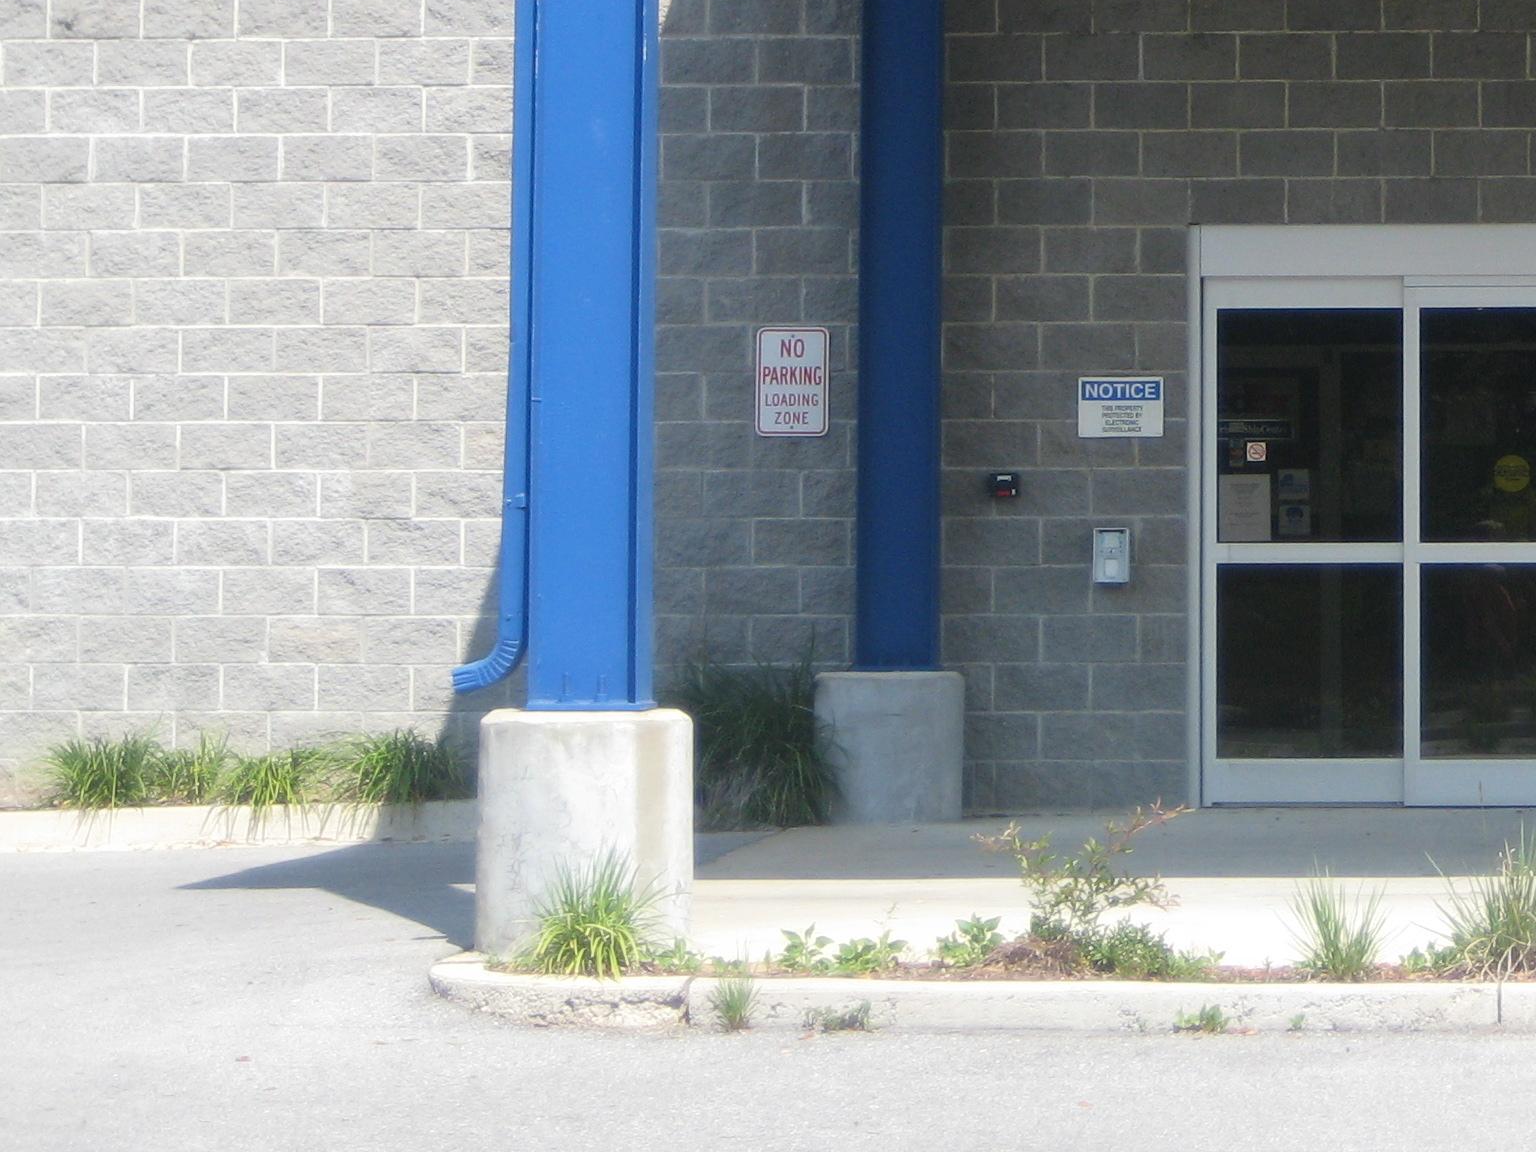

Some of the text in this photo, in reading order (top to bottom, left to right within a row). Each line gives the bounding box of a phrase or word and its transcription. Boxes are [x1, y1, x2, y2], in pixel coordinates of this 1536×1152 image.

[780, 338, 805, 358] NO
[762, 365, 823, 386] PARKING
[1084, 383, 1157, 399] NOTICE
[765, 393, 820, 407] LOADING
[774, 411, 809, 425] ZONE
